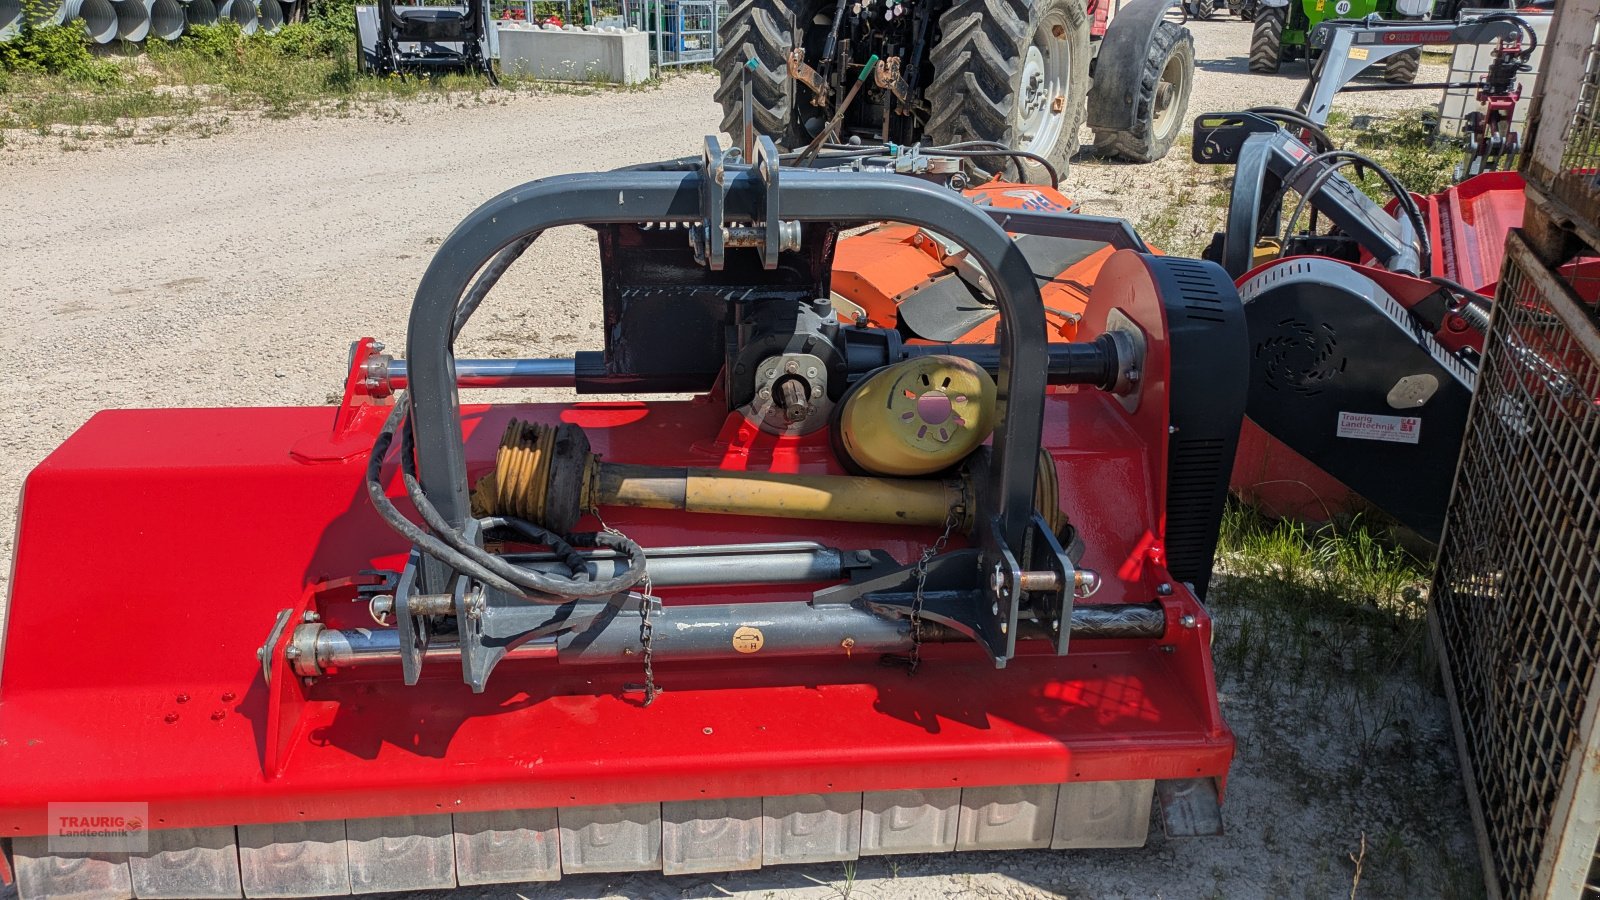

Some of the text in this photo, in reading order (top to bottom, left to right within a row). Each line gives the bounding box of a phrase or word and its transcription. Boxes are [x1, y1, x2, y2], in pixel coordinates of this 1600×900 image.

[1337, 2, 1349, 12] 40
[1343, 413, 1373, 423] Traurig
[1341, 421, 1395, 431] Landtechnik
